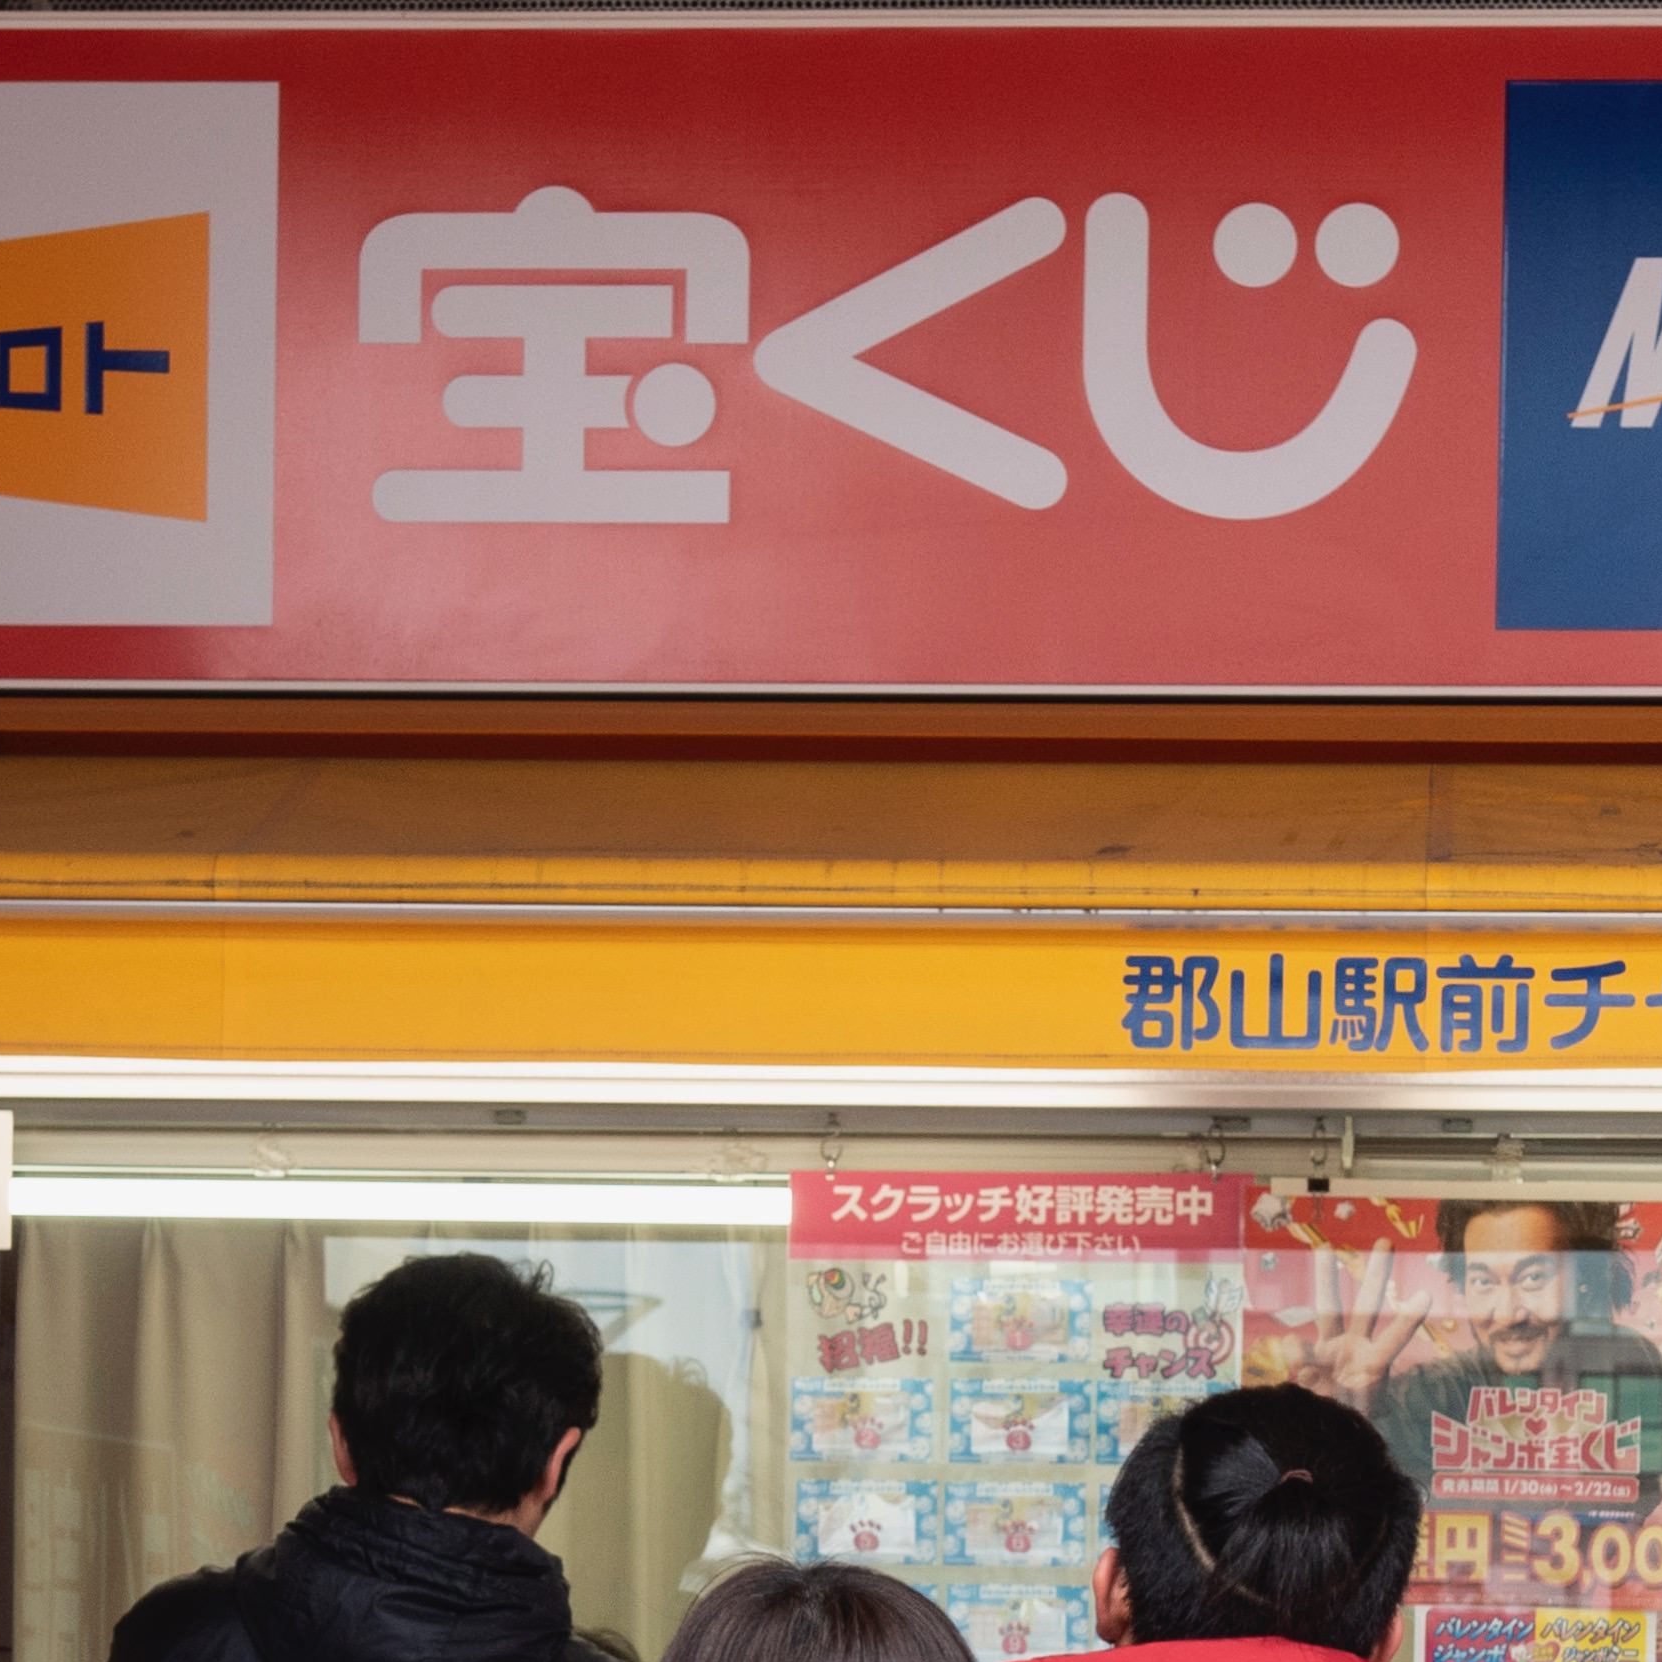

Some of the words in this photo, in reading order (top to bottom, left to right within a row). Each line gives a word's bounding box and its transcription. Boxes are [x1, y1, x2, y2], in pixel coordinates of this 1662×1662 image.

[358, 185, 1417, 522] 宝くじ
[830, 1184, 1215, 1224] スクラッチ好評発売中
[900, 1231, 1141, 1258] ご自由にお選び下さい
[1103, 1346, 1217, 1380] チャンス
[1467, 1386, 1608, 1424] バレンタイン
[1431, 1411, 1642, 1472] ジャンボ宝くじ
[1435, 1616, 1534, 1641] バレンタイン
[1540, 1616, 1640, 1644] バレンタイン
